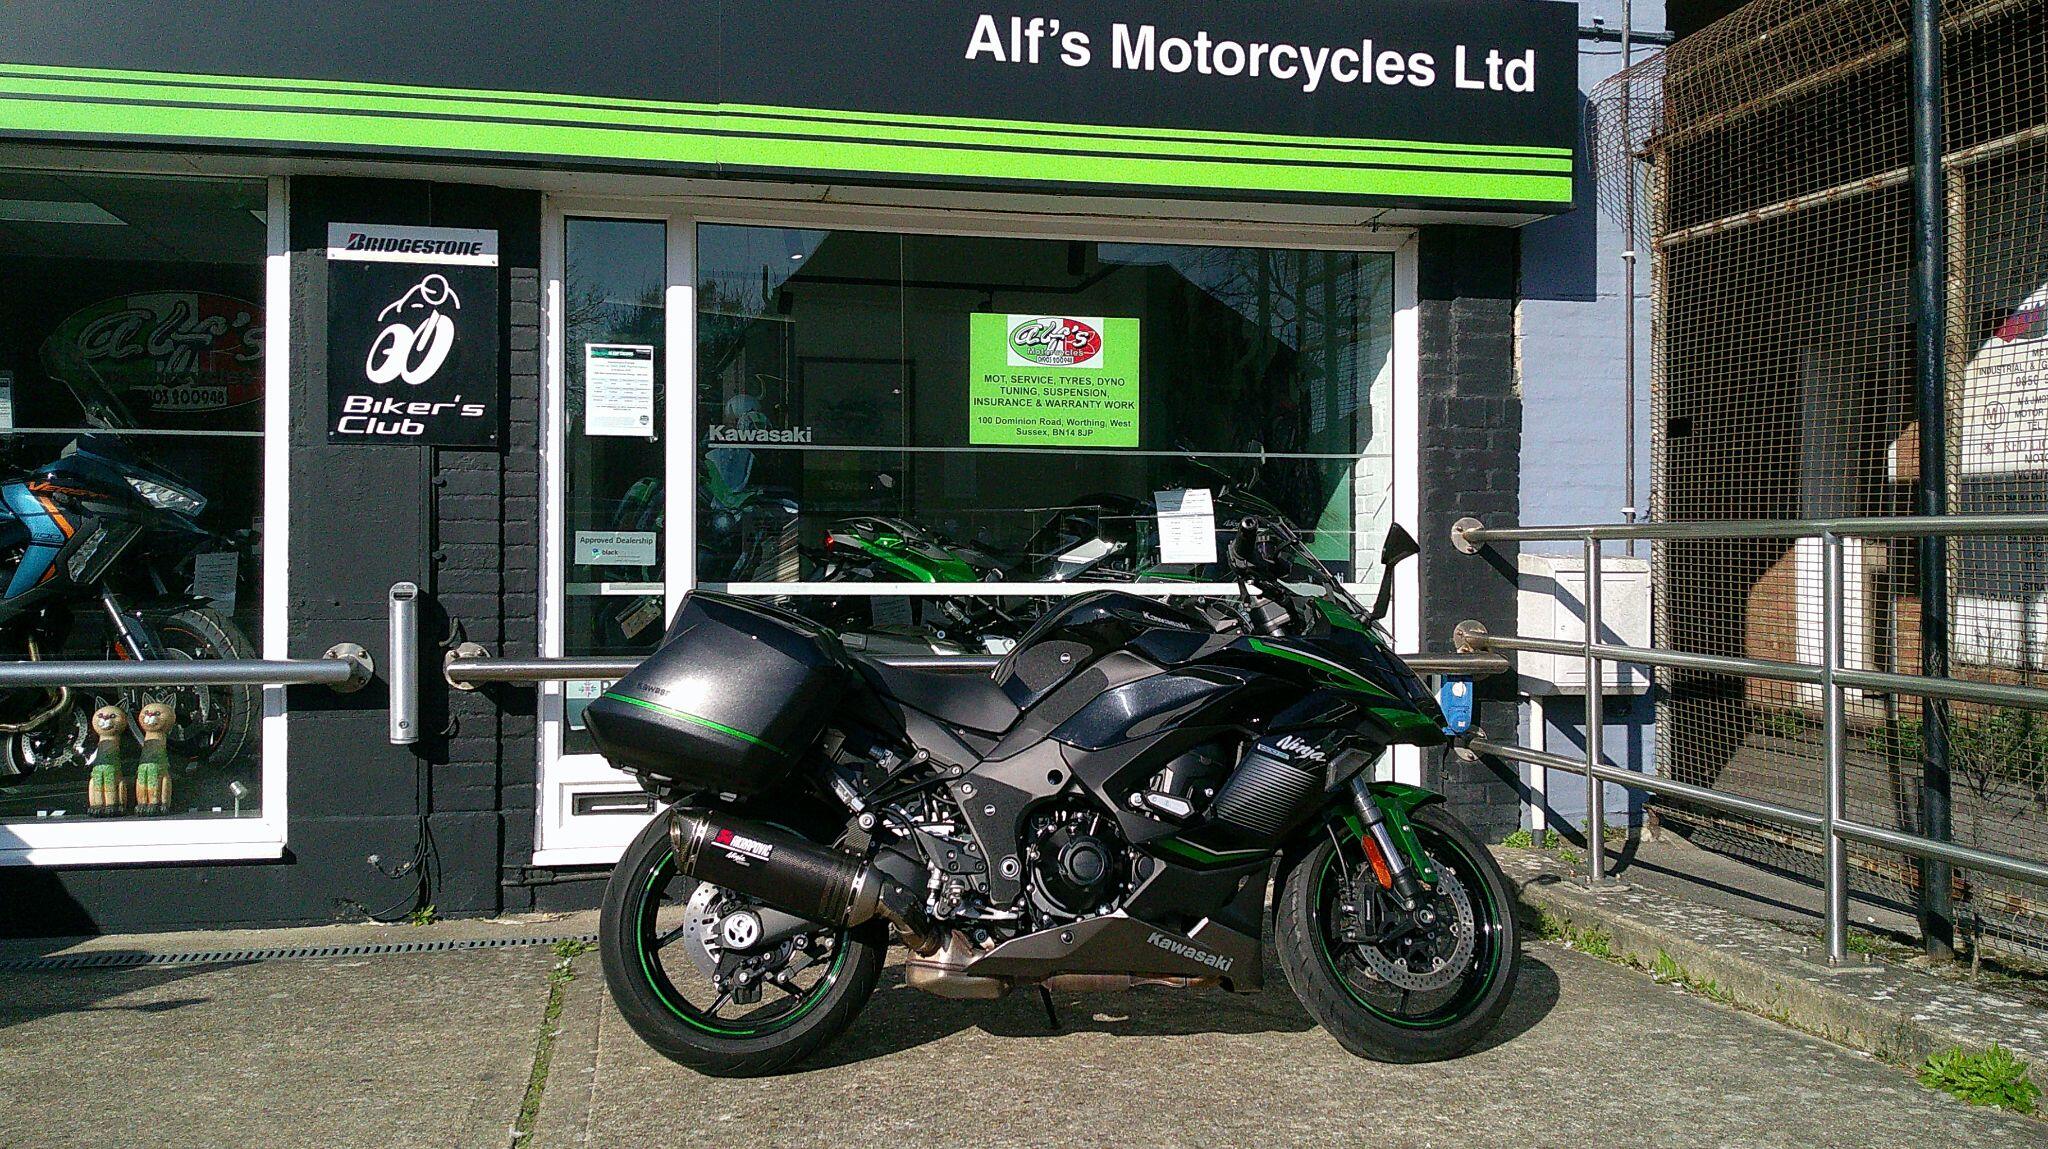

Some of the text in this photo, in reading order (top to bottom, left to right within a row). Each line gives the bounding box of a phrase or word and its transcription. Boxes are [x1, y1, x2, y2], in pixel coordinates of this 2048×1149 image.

[964, 13, 1535, 93] Alf's Motorcycles Ltd
[345, 233, 483, 257] BRIDGESTONE
[1980, 363, 2023, 376] INDUSTRIAL
[984, 374, 1126, 387] MOT, SERVICE, TYRES, DYNO
[1000, 386, 1110, 398] TUNING, SUSPENSION,
[343, 394, 486, 417] Biker's
[973, 397, 1136, 410] INSURANCE & WARRANTY WORK
[337, 415, 425, 436] Club
[978, 416, 1132, 429] 100 Dominion Road, Worthing, West
[709, 424, 812, 443] Kawasaki
[1016, 427, 1094, 437] Sussex, BN14 8JP
[580, 536, 654, 546] Approved Dealership
[1276, 735, 1327, 762] Ninja
[1146, 932, 1234, 972] Kawasaki
